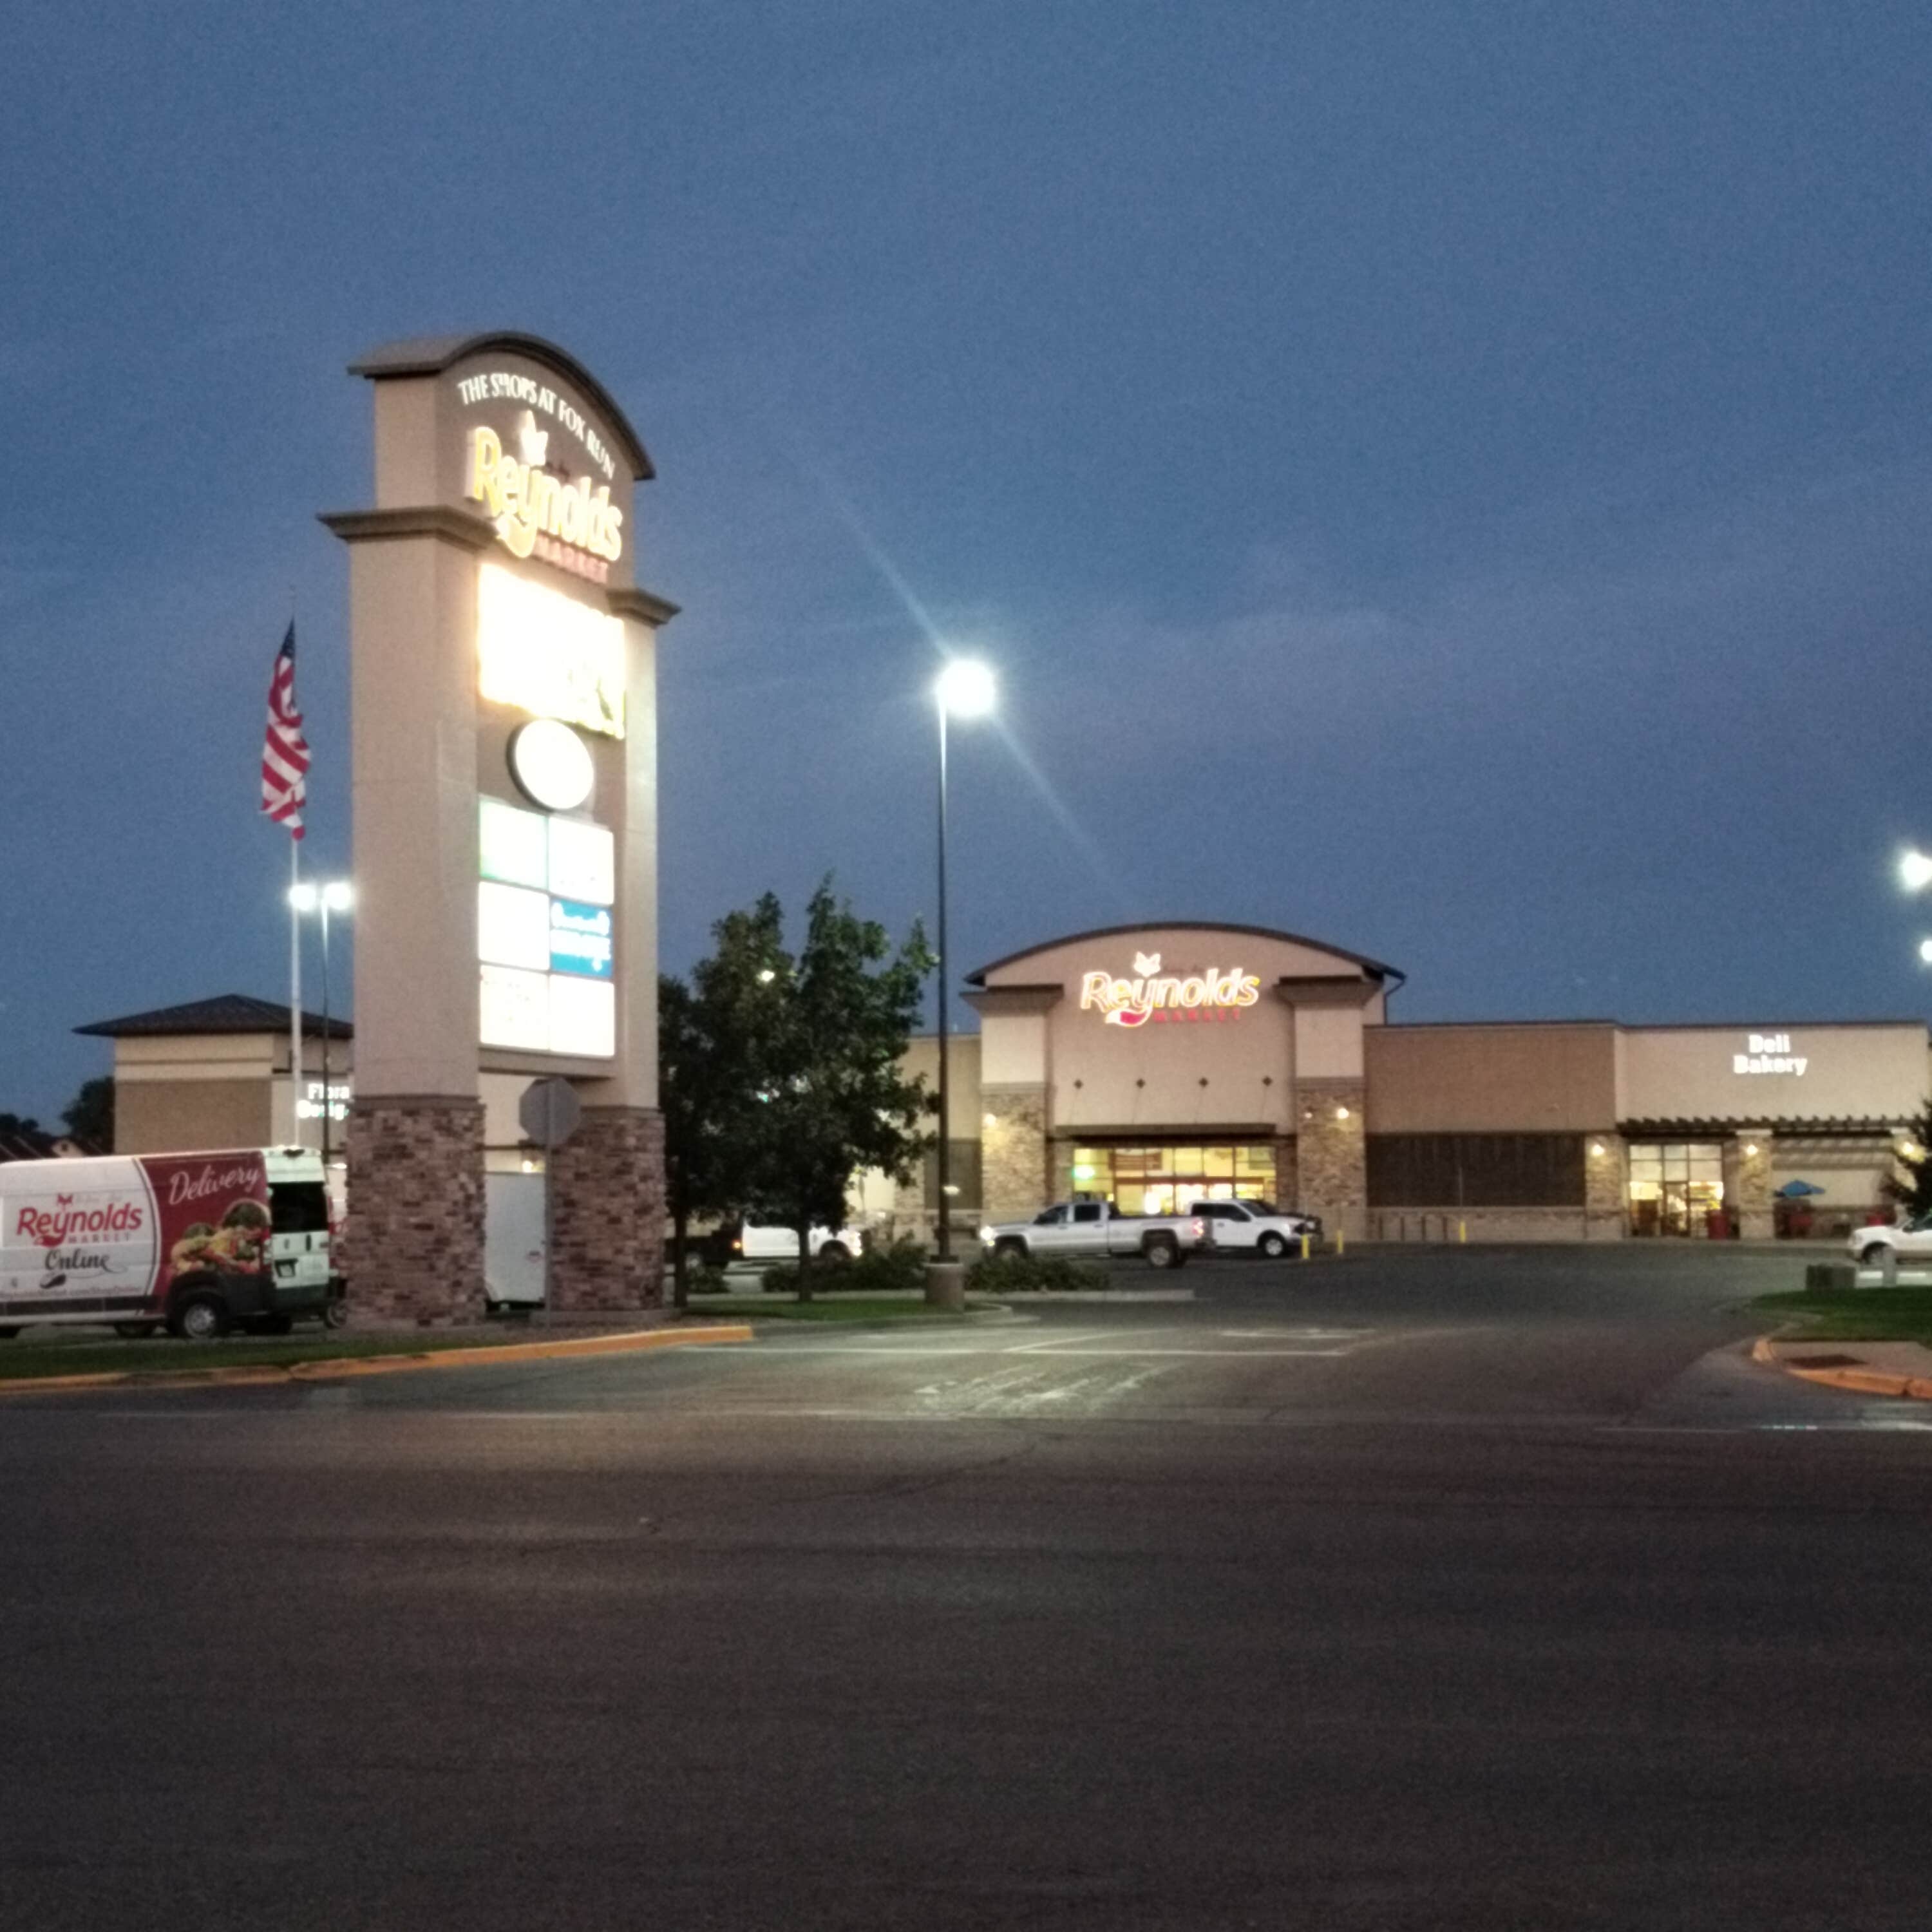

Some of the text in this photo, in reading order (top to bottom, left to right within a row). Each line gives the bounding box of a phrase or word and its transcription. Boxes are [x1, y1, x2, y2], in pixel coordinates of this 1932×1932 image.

[457, 374, 489, 406] THE
[490, 372, 538, 404] SHOPS
[538, 387, 556, 415] AT
[558, 399, 585, 442] FOX
[587, 428, 615, 480] RUN
[472, 426, 623, 562] Reynolds
[1080, 967, 1260, 1027] Reynolds
[1733, 1054, 1808, 1076] Bakery
[169, 1164, 260, 1206] Delivery
[16, 1202, 142, 1248] Reynolds
[44, 1248, 118, 1273] Online
